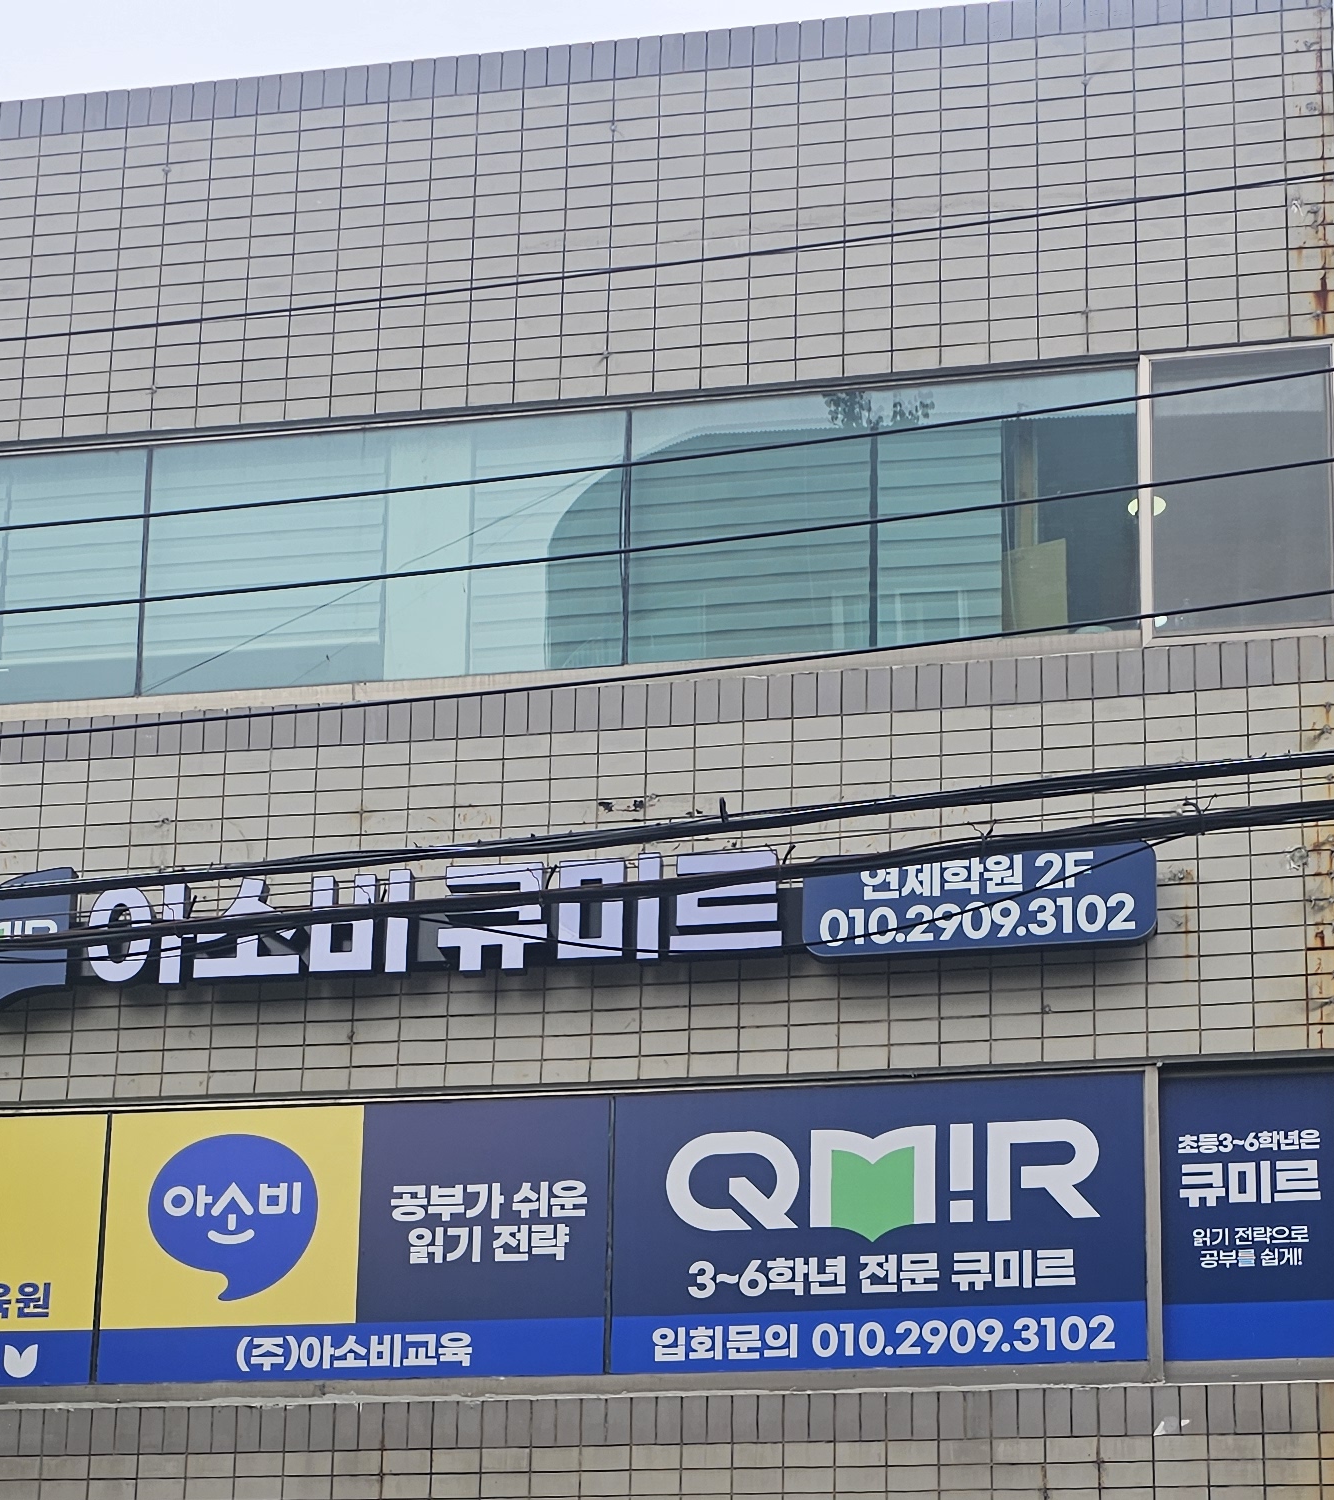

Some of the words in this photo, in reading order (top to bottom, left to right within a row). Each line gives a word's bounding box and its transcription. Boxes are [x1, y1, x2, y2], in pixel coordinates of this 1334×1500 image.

[860, 854, 1023, 900] 연제학원
[1035, 850, 1094, 889] 2F
[87, 869, 411, 984] 아소비
[437, 850, 782, 971] 큐미르
[820, 892, 1136, 947] 010.2909.3102
[1177, 1129, 1321, 1154] 초등3~6학년은
[390, 1182, 505, 1222] 공부가
[512, 1179, 589, 1219] 쉬운
[1179, 1159, 1322, 1208] 큐미르
[163, 1181, 302, 1245] 아소비
[1192, 1228, 1229, 1247] 읽기
[1234, 1225, 1310, 1246] 전략으로
[408, 1226, 481, 1264] 읽기
[492, 1223, 570, 1263] 전략
[1199, 1249, 1256, 1269] 공부를
[1260, 1248, 1303, 1267] 쉽게!
[686, 1253, 848, 1299] 3~6학년
[858, 1251, 939, 1294] 전문
[952, 1248, 1077, 1293] 큐미르
[235, 1331, 473, 1372] (주)아소비교육
[652, 1323, 798, 1363] 입회문의
[813, 1314, 1117, 1360] 010.2909.3102
